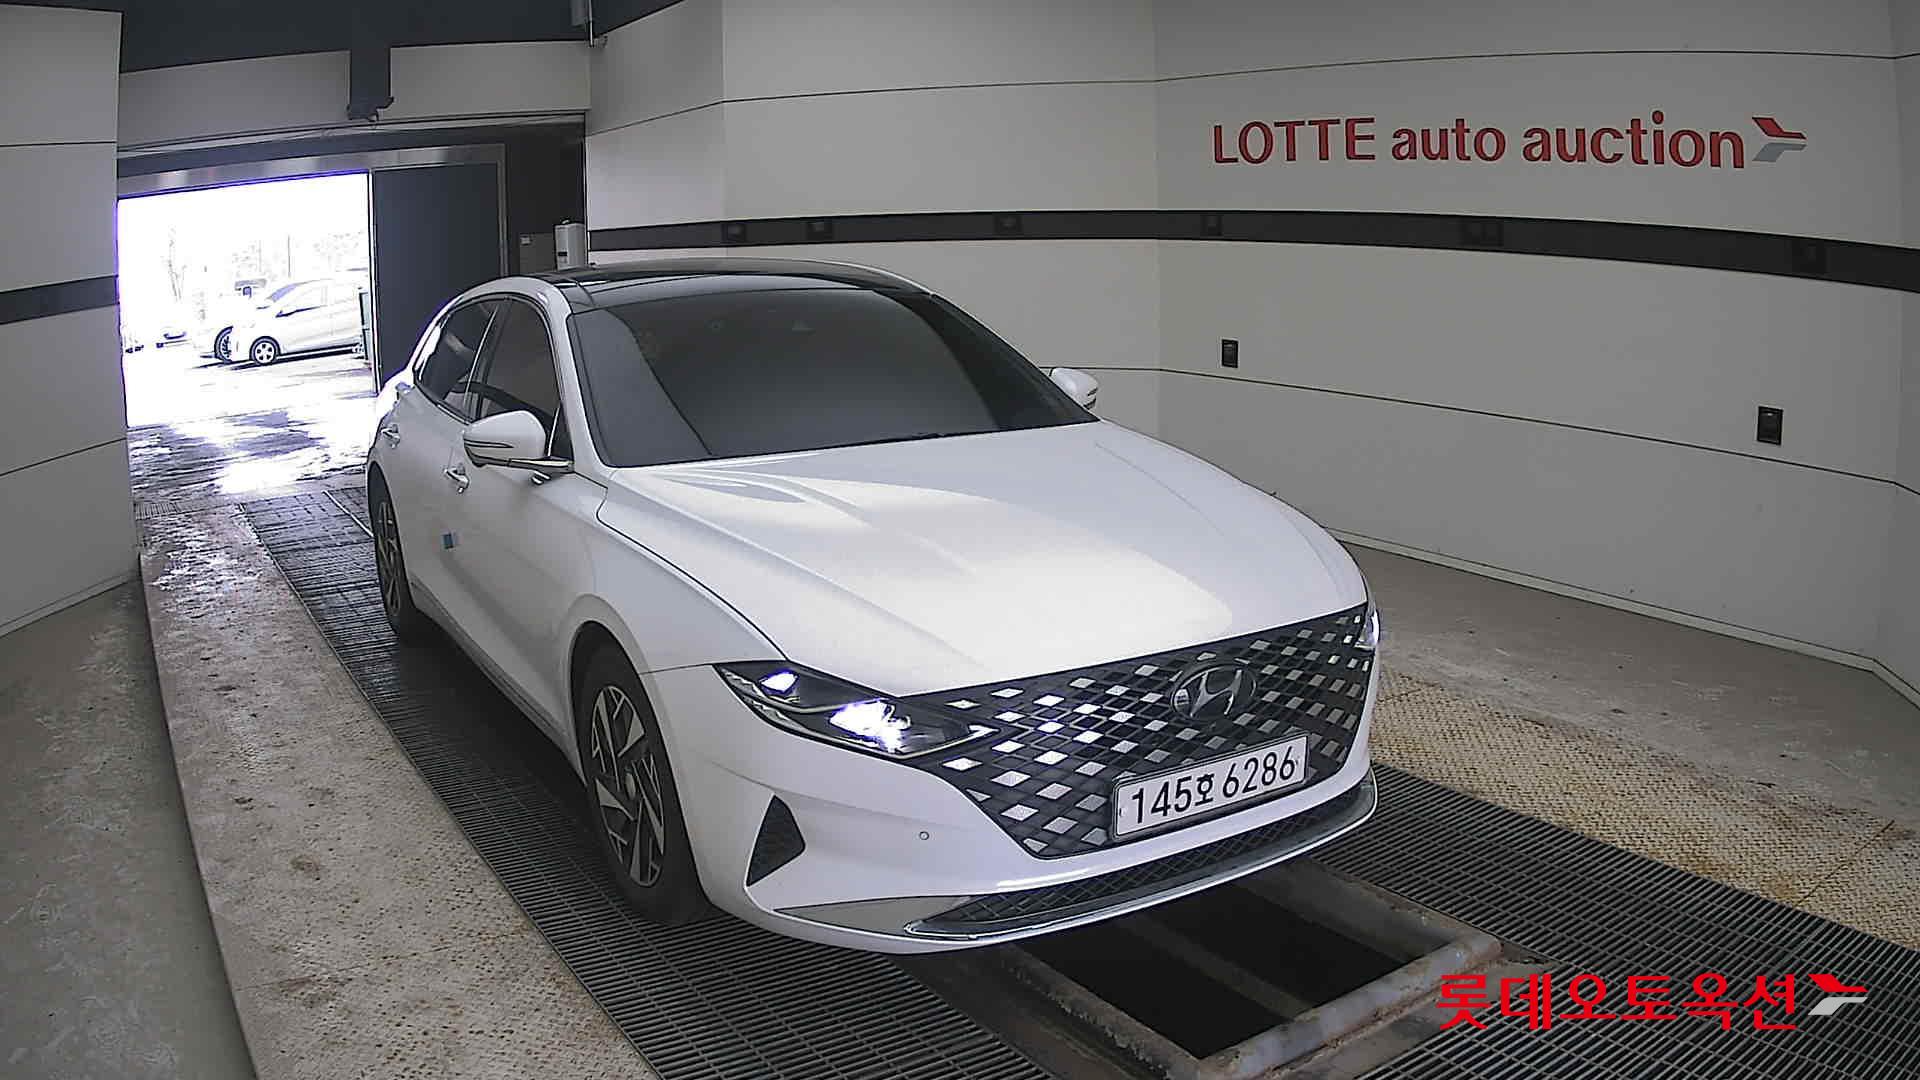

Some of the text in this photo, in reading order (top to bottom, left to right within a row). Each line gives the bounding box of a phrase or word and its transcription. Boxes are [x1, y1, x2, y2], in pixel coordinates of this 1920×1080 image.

[1212, 110, 1745, 169] LOTTE auto auction
[1131, 746, 1296, 824] 145호 6286
